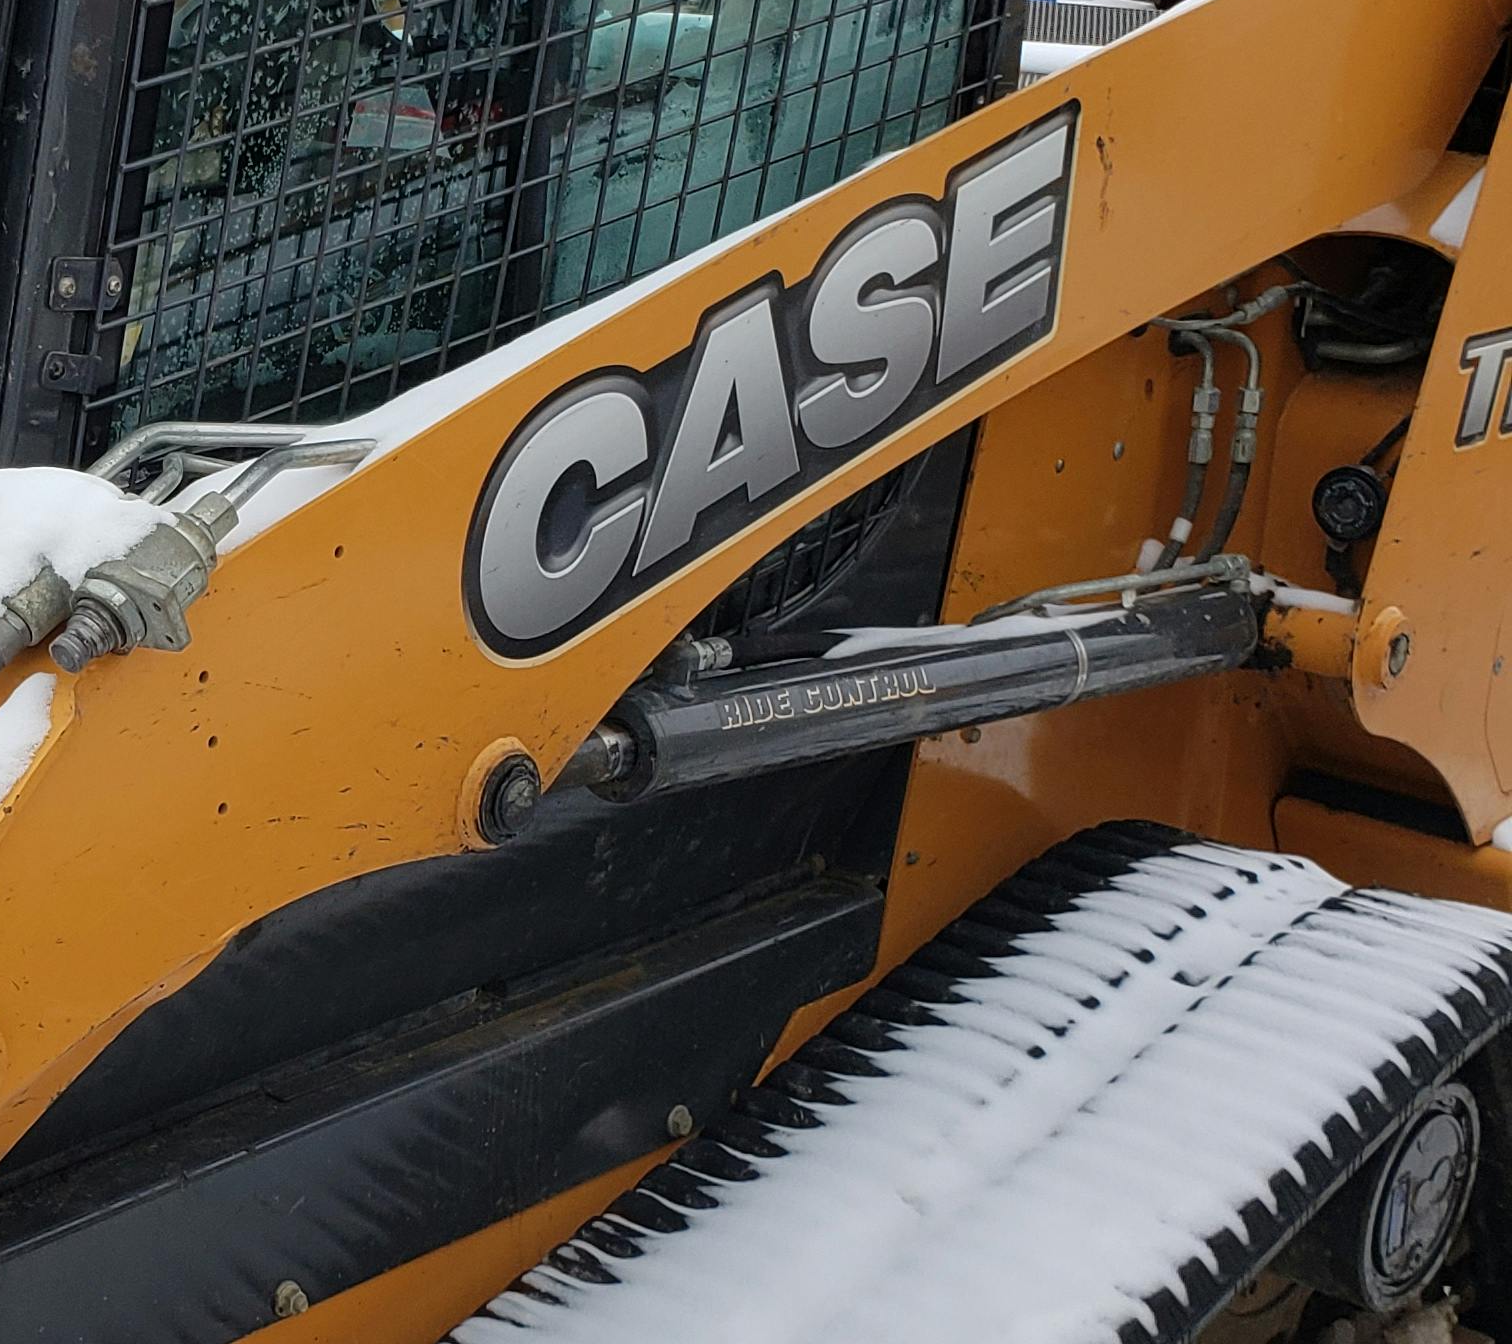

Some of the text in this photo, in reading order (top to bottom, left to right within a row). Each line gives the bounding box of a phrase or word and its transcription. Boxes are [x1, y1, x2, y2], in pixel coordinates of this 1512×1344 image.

[473, 116, 1074, 648] CASE
[1455, 327, 1512, 448] T
[720, 664, 937, 731] RIDE CONTROL
